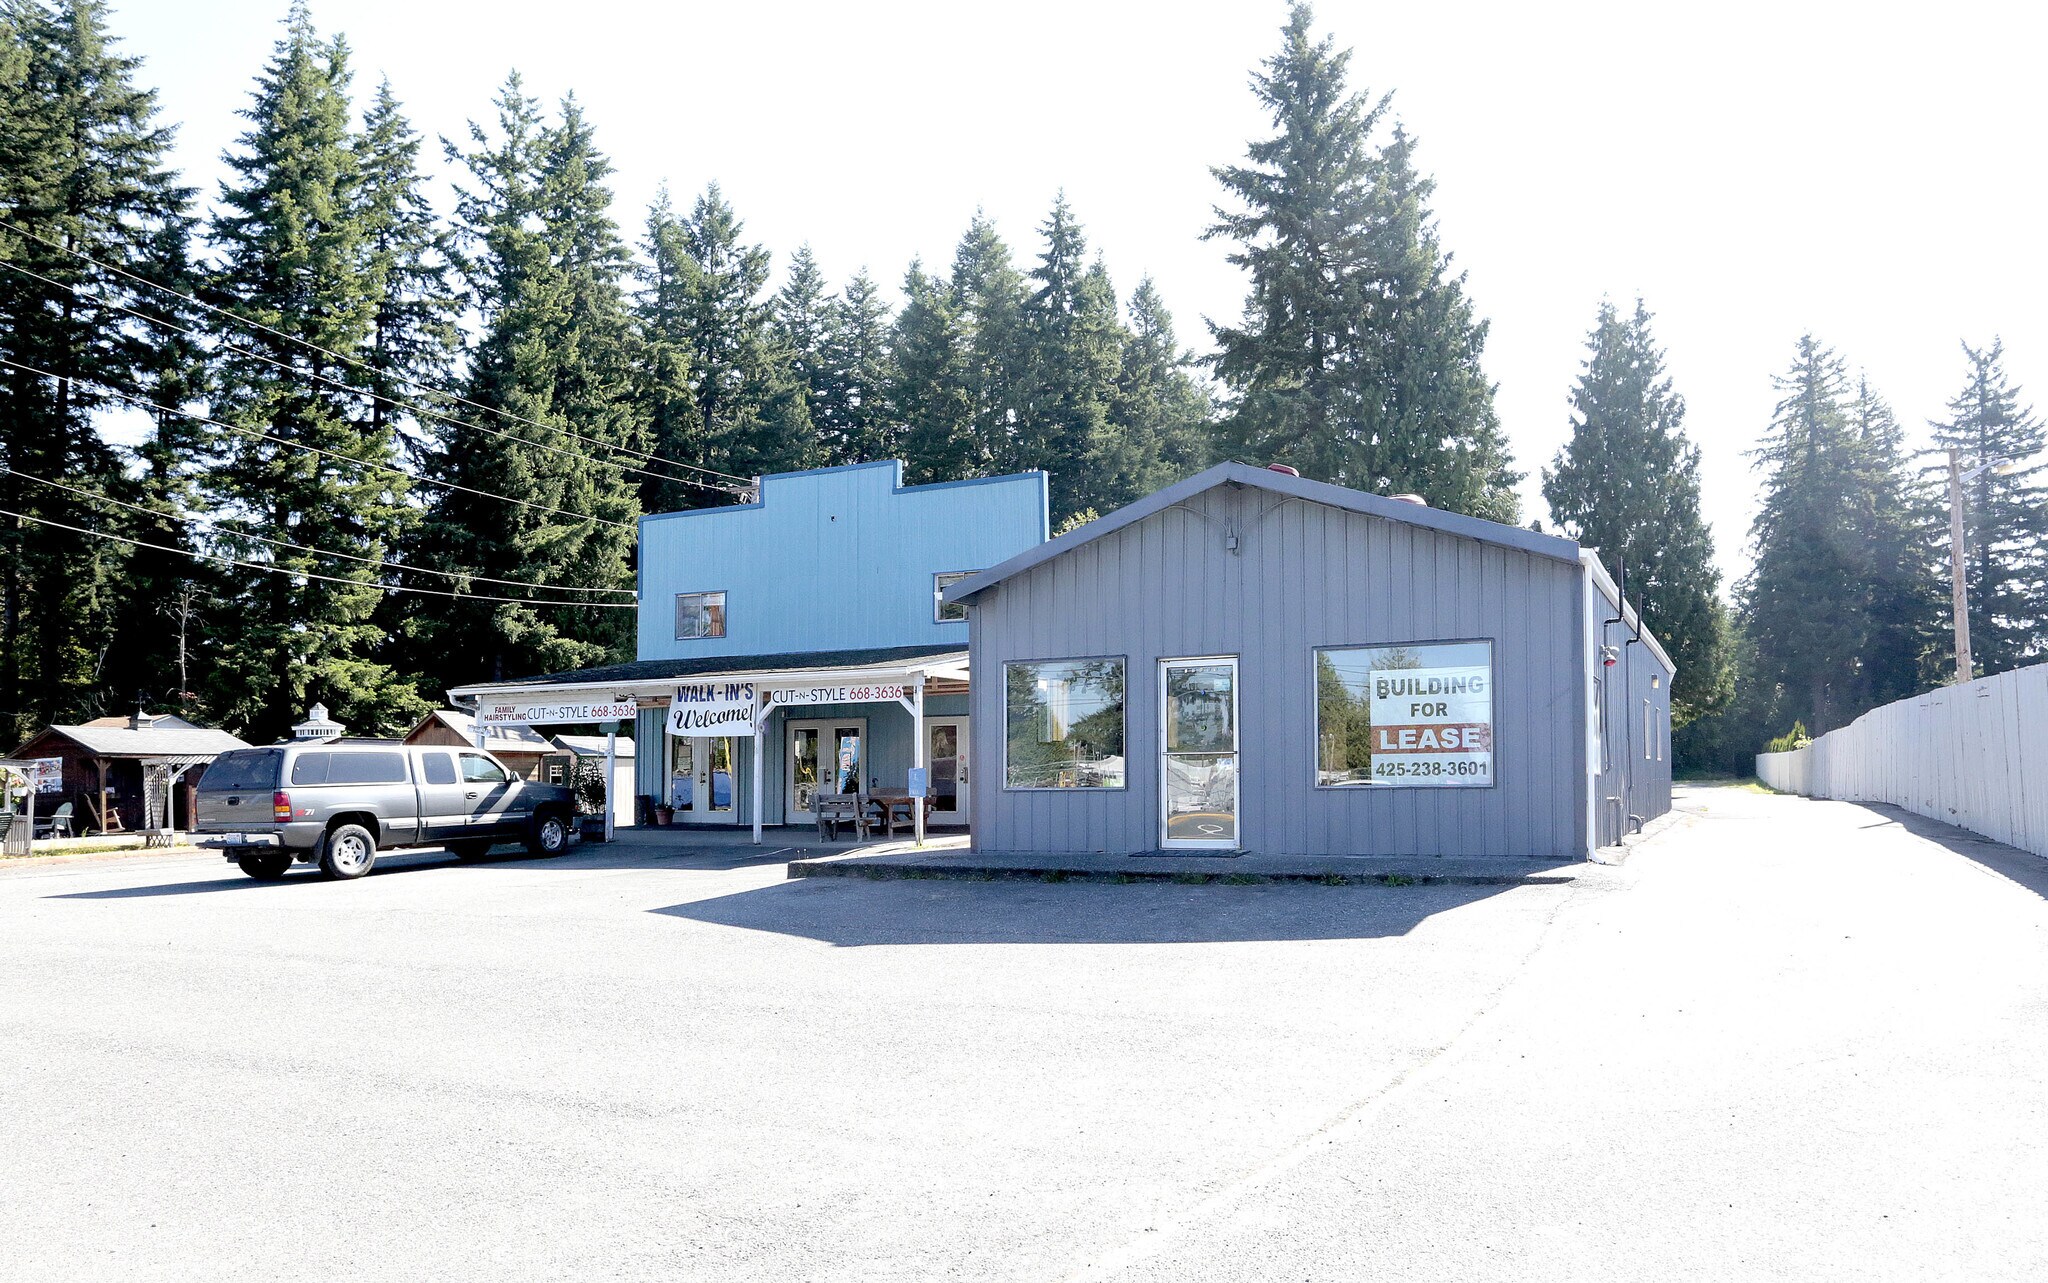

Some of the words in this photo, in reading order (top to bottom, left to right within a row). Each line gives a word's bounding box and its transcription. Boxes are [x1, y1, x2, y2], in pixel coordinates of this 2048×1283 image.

[849, 686, 902, 700] 668-3636
[1376, 676, 1484, 697] BUILDING
[484, 713, 527, 721] HAIRSTYLING
[591, 704, 636, 718] 668-3636
[673, 704, 754, 729] Welcome!
[1410, 702, 1448, 717] FOR
[1380, 727, 1481, 750] LEASE
[1375, 761, 1487, 776] 425-238-3601
